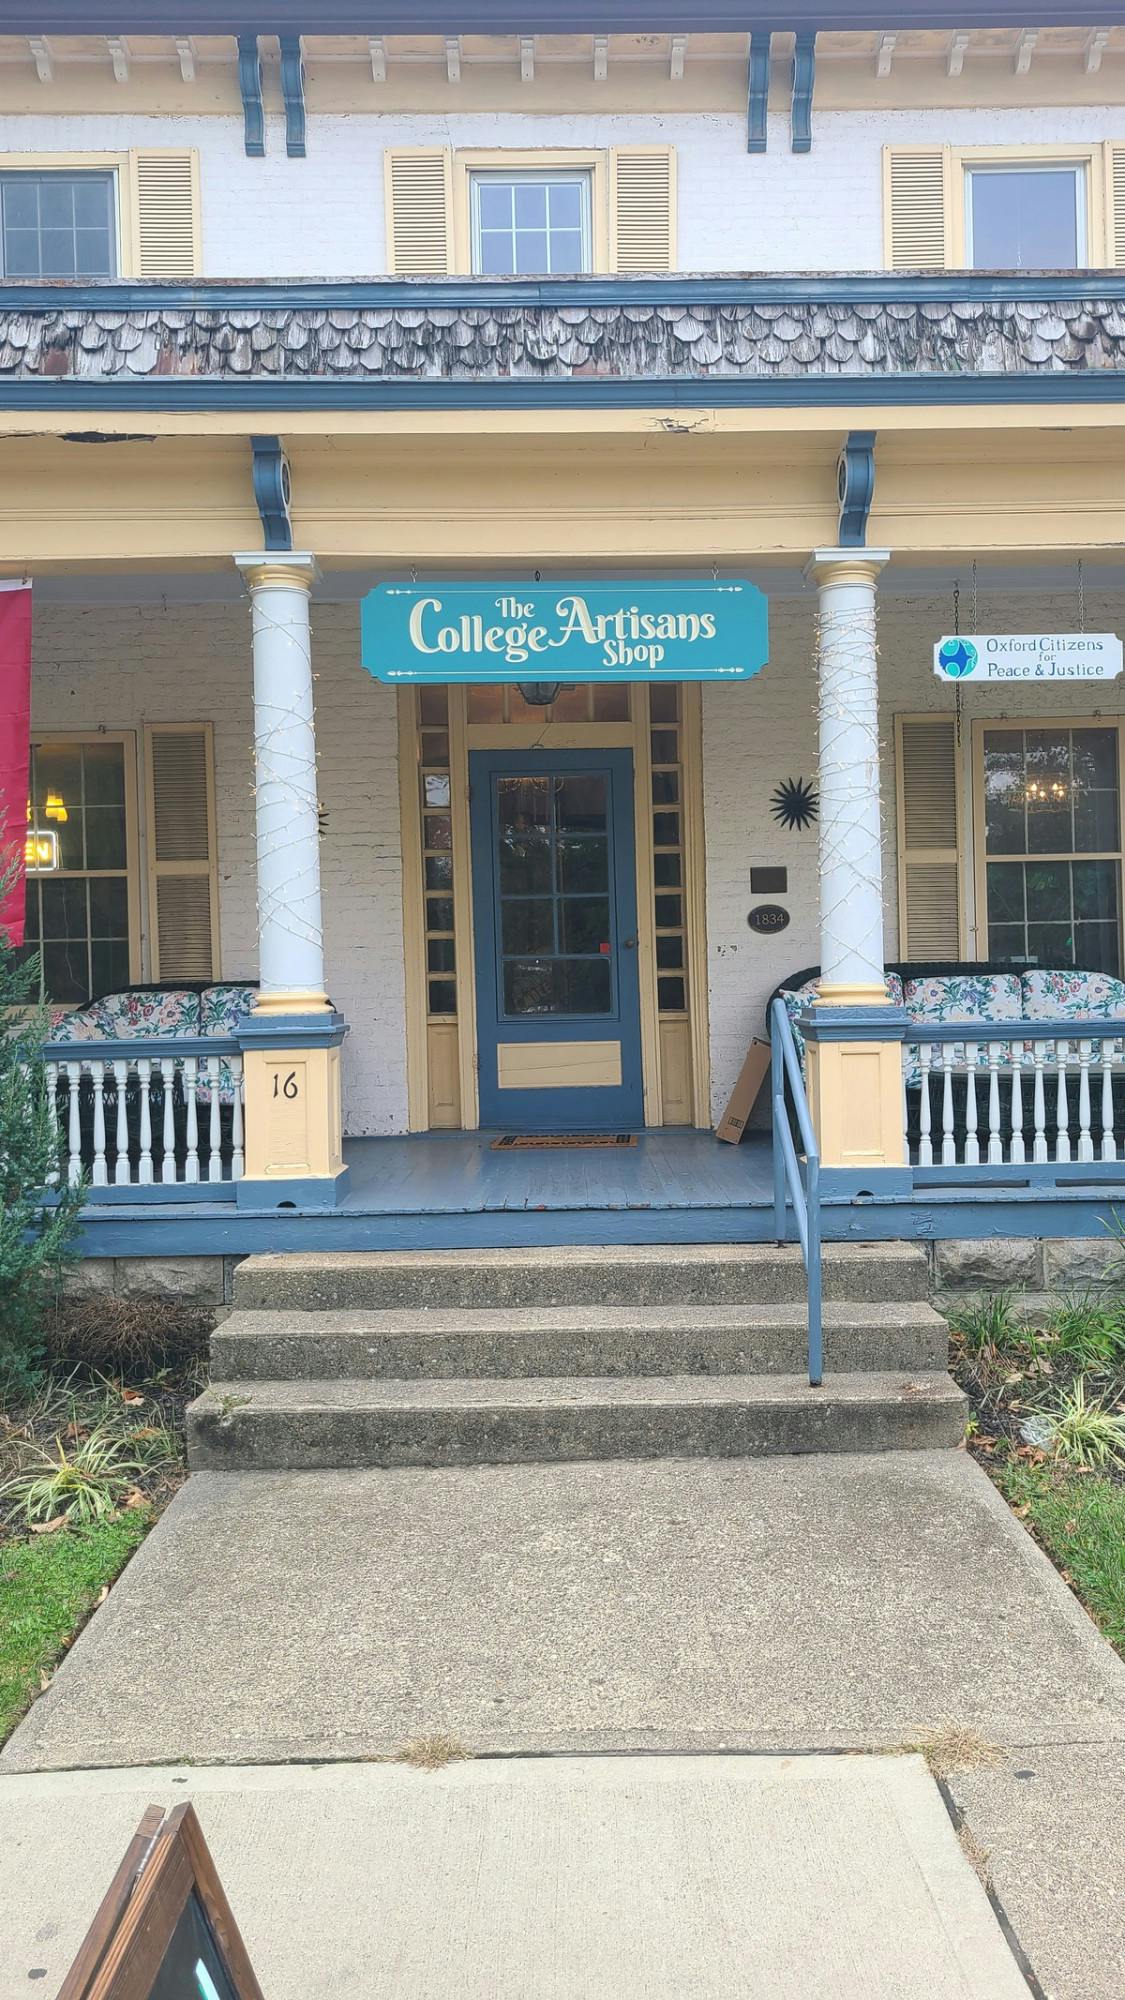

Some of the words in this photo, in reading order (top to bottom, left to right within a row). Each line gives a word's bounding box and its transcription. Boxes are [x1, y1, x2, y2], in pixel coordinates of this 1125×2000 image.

[494, 596, 536, 619] The
[409, 598, 549, 663] College
[548, 596, 716, 647] Artisans
[602, 639, 665, 669] Shop
[986, 638, 1036, 652] Oxford
[1039, 637, 1103, 652] Citizens
[1039, 652, 1056, 662] for
[988, 663, 1030, 677] Peace
[1034, 664, 1044, 676] &
[1047, 662, 1104, 676] Justice
[755, 913, 785, 926] 1834
[273, 1071, 298, 1099] 16
